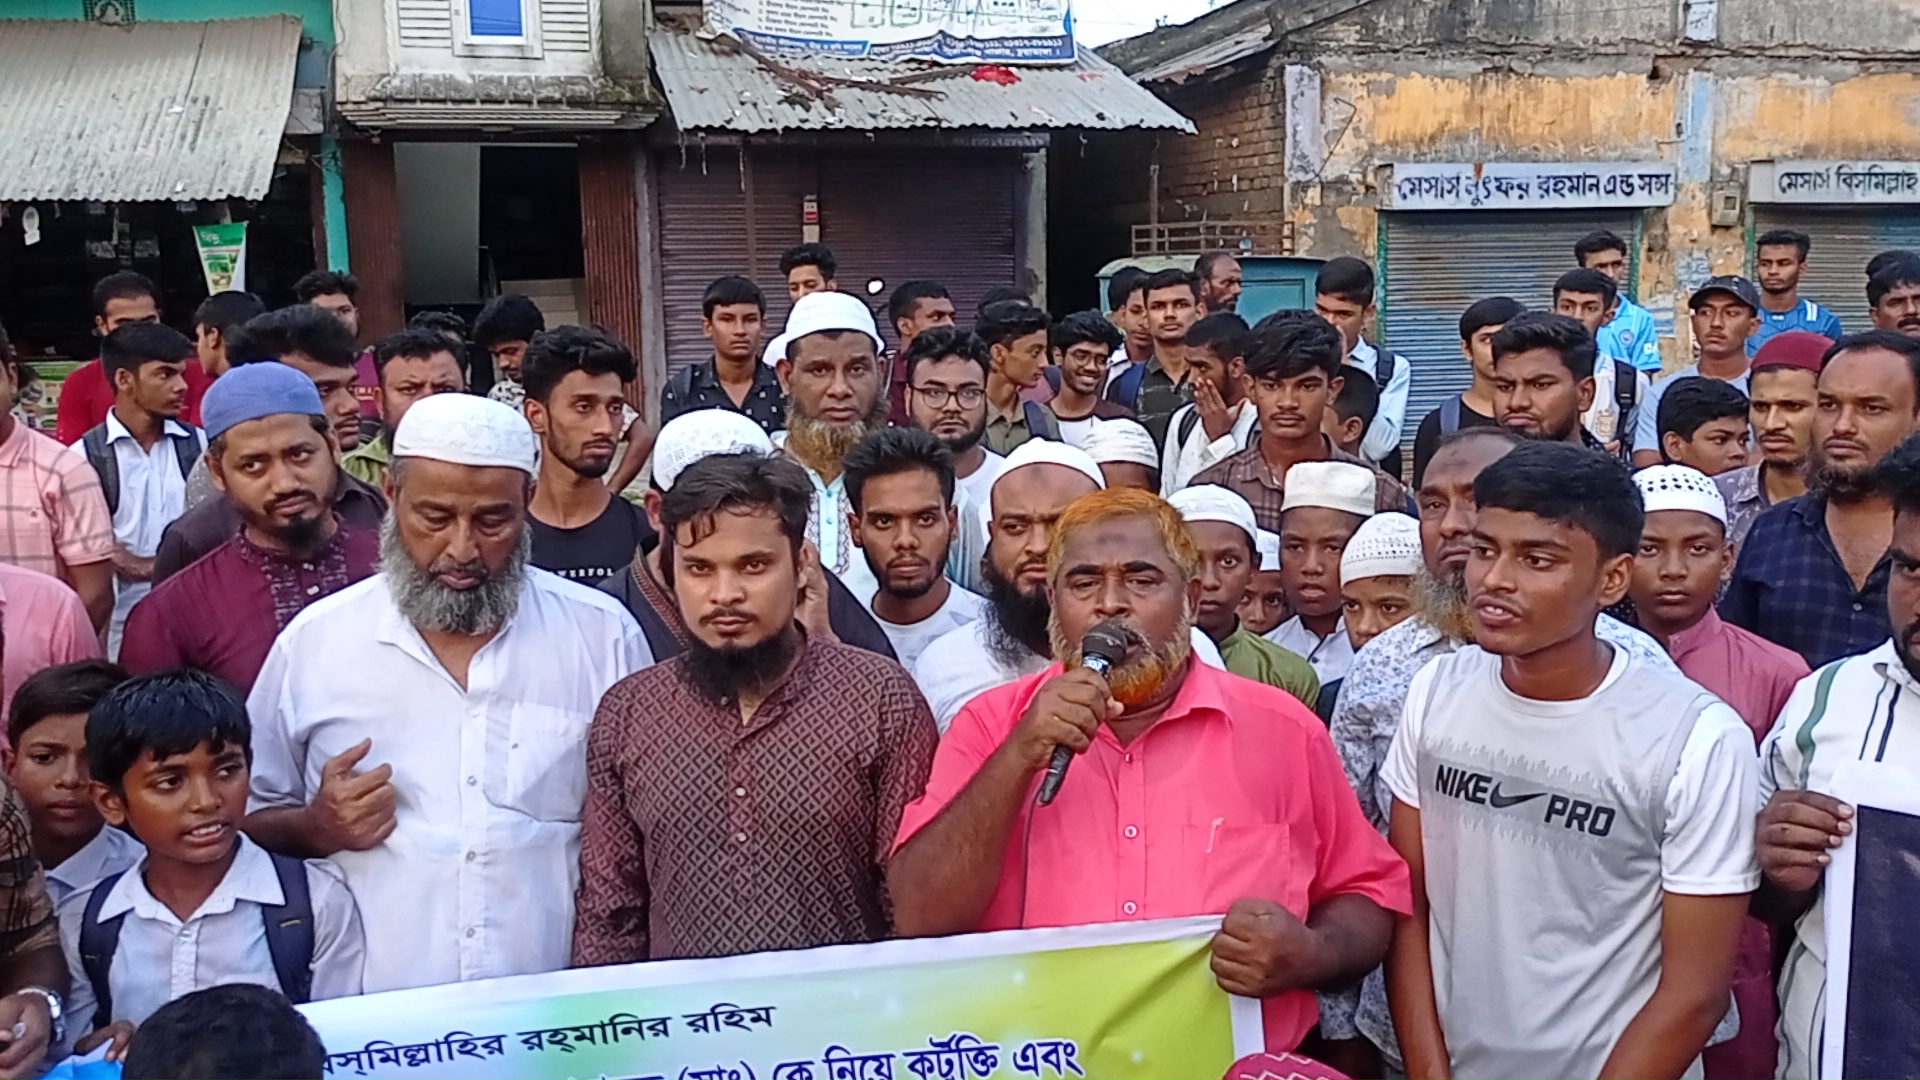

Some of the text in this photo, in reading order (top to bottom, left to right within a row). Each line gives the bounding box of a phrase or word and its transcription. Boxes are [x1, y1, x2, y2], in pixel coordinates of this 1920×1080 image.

[1536, 171, 1600, 200] রহমান
[1435, 764, 1616, 837] NIKE PRO
[682, 1002, 776, 1034] রহিম
[1012, 1040, 1083, 1077] এবং
